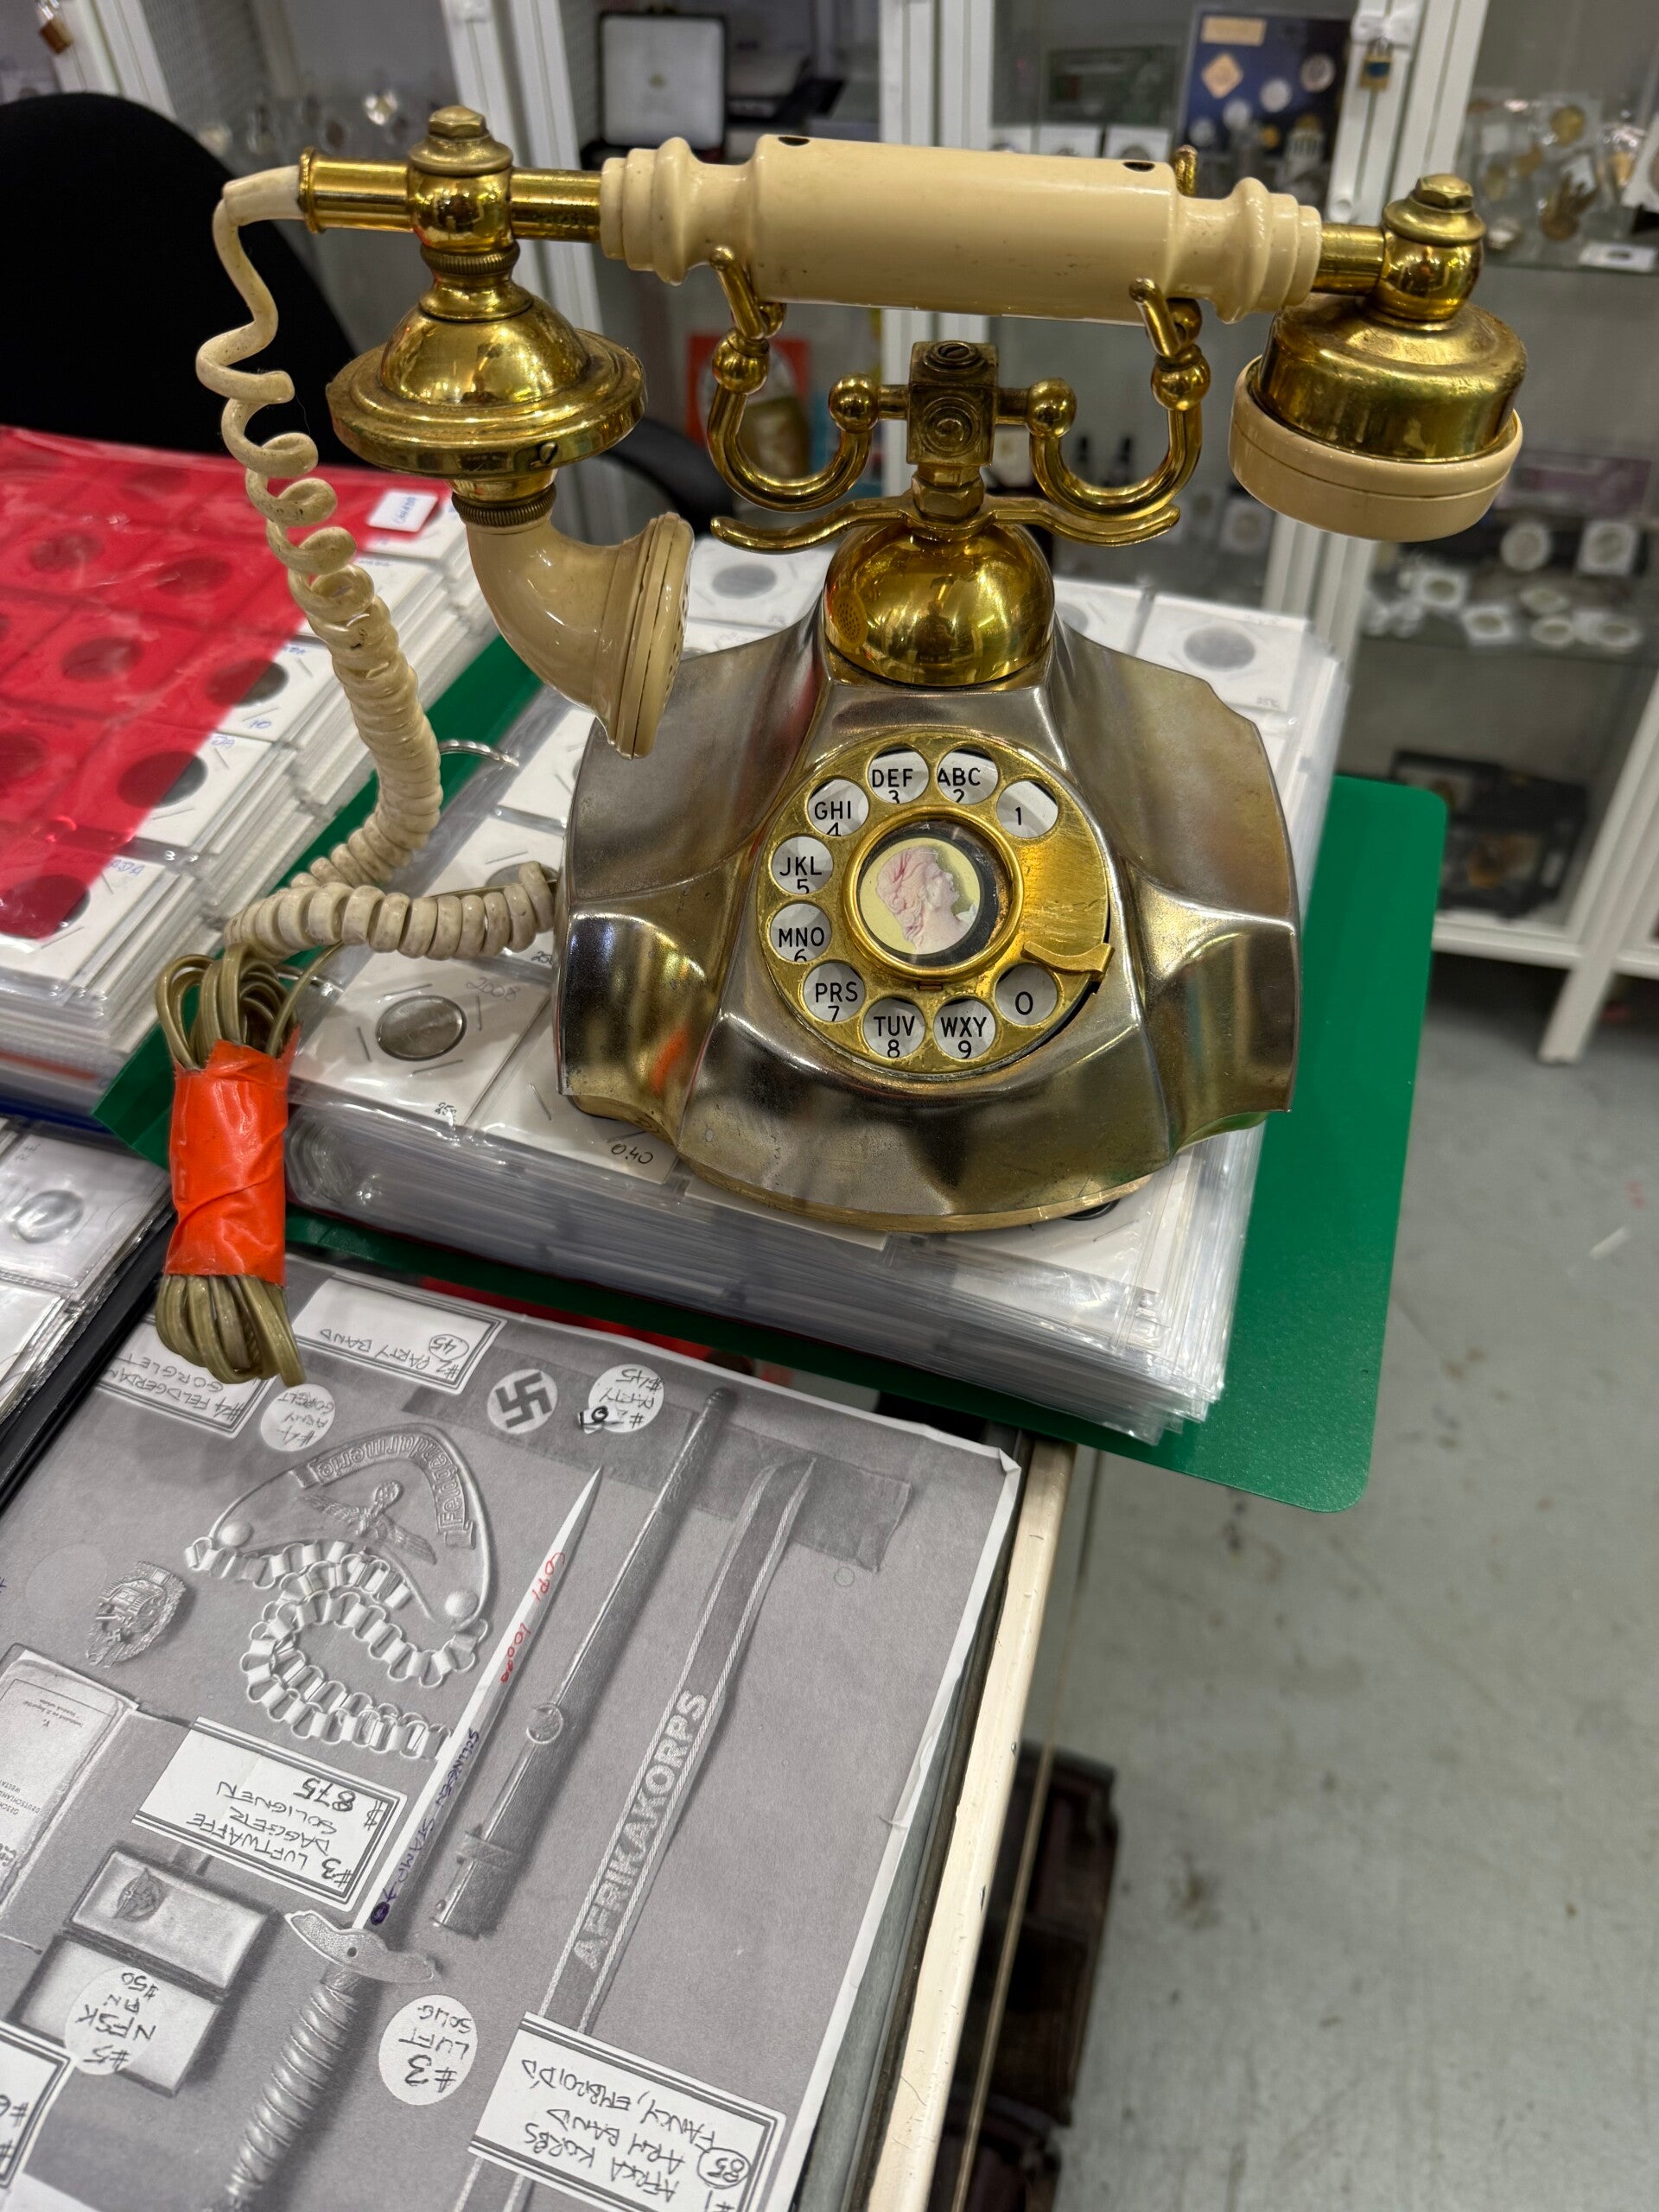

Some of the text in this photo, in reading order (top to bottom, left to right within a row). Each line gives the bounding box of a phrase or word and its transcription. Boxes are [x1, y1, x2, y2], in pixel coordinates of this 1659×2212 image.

[871, 767, 914, 788] DEF
[937, 767, 982, 787] ABC
[888, 790, 900, 804] 3
[952, 788, 965, 804] 2
[813, 800, 852, 821] GHI
[1014, 806, 1023, 827] 1
[825, 822, 842, 836] 4
[779, 855, 823, 877] JKL
[796, 878, 810, 895] 5
[778, 926, 825, 948] MNO
[814, 982, 859, 1003] PRS
[827, 1005, 842, 1022] 7
[873, 1015, 916, 1038] TUV
[940, 1015, 987, 1038] WXY
[886, 1039, 900, 1058] 8
[957, 1039, 972, 1059] 9
[320, 1328, 460, 1380] #2 PARTY BAND
[430, 1336, 459, 1355] 45
[0, 1778, 21, 1793] WELTA
[292, 1777, 357, 1813] 875
[229, 1806, 330, 1856] DAGGER
[572, 1689, 709, 1971] AFRIKAKORPS
[187, 1813, 353, 1888] #3 LUFTWAFFE
[75, 2004, 157, 2041] NFSK
[398, 2027, 470, 2061] LUFT
[83, 2044, 130, 2072] #5
[404, 2053, 458, 2093] #3
[546, 2108, 686, 2176] ARM BAND
[707, 2158, 746, 2183] 85
